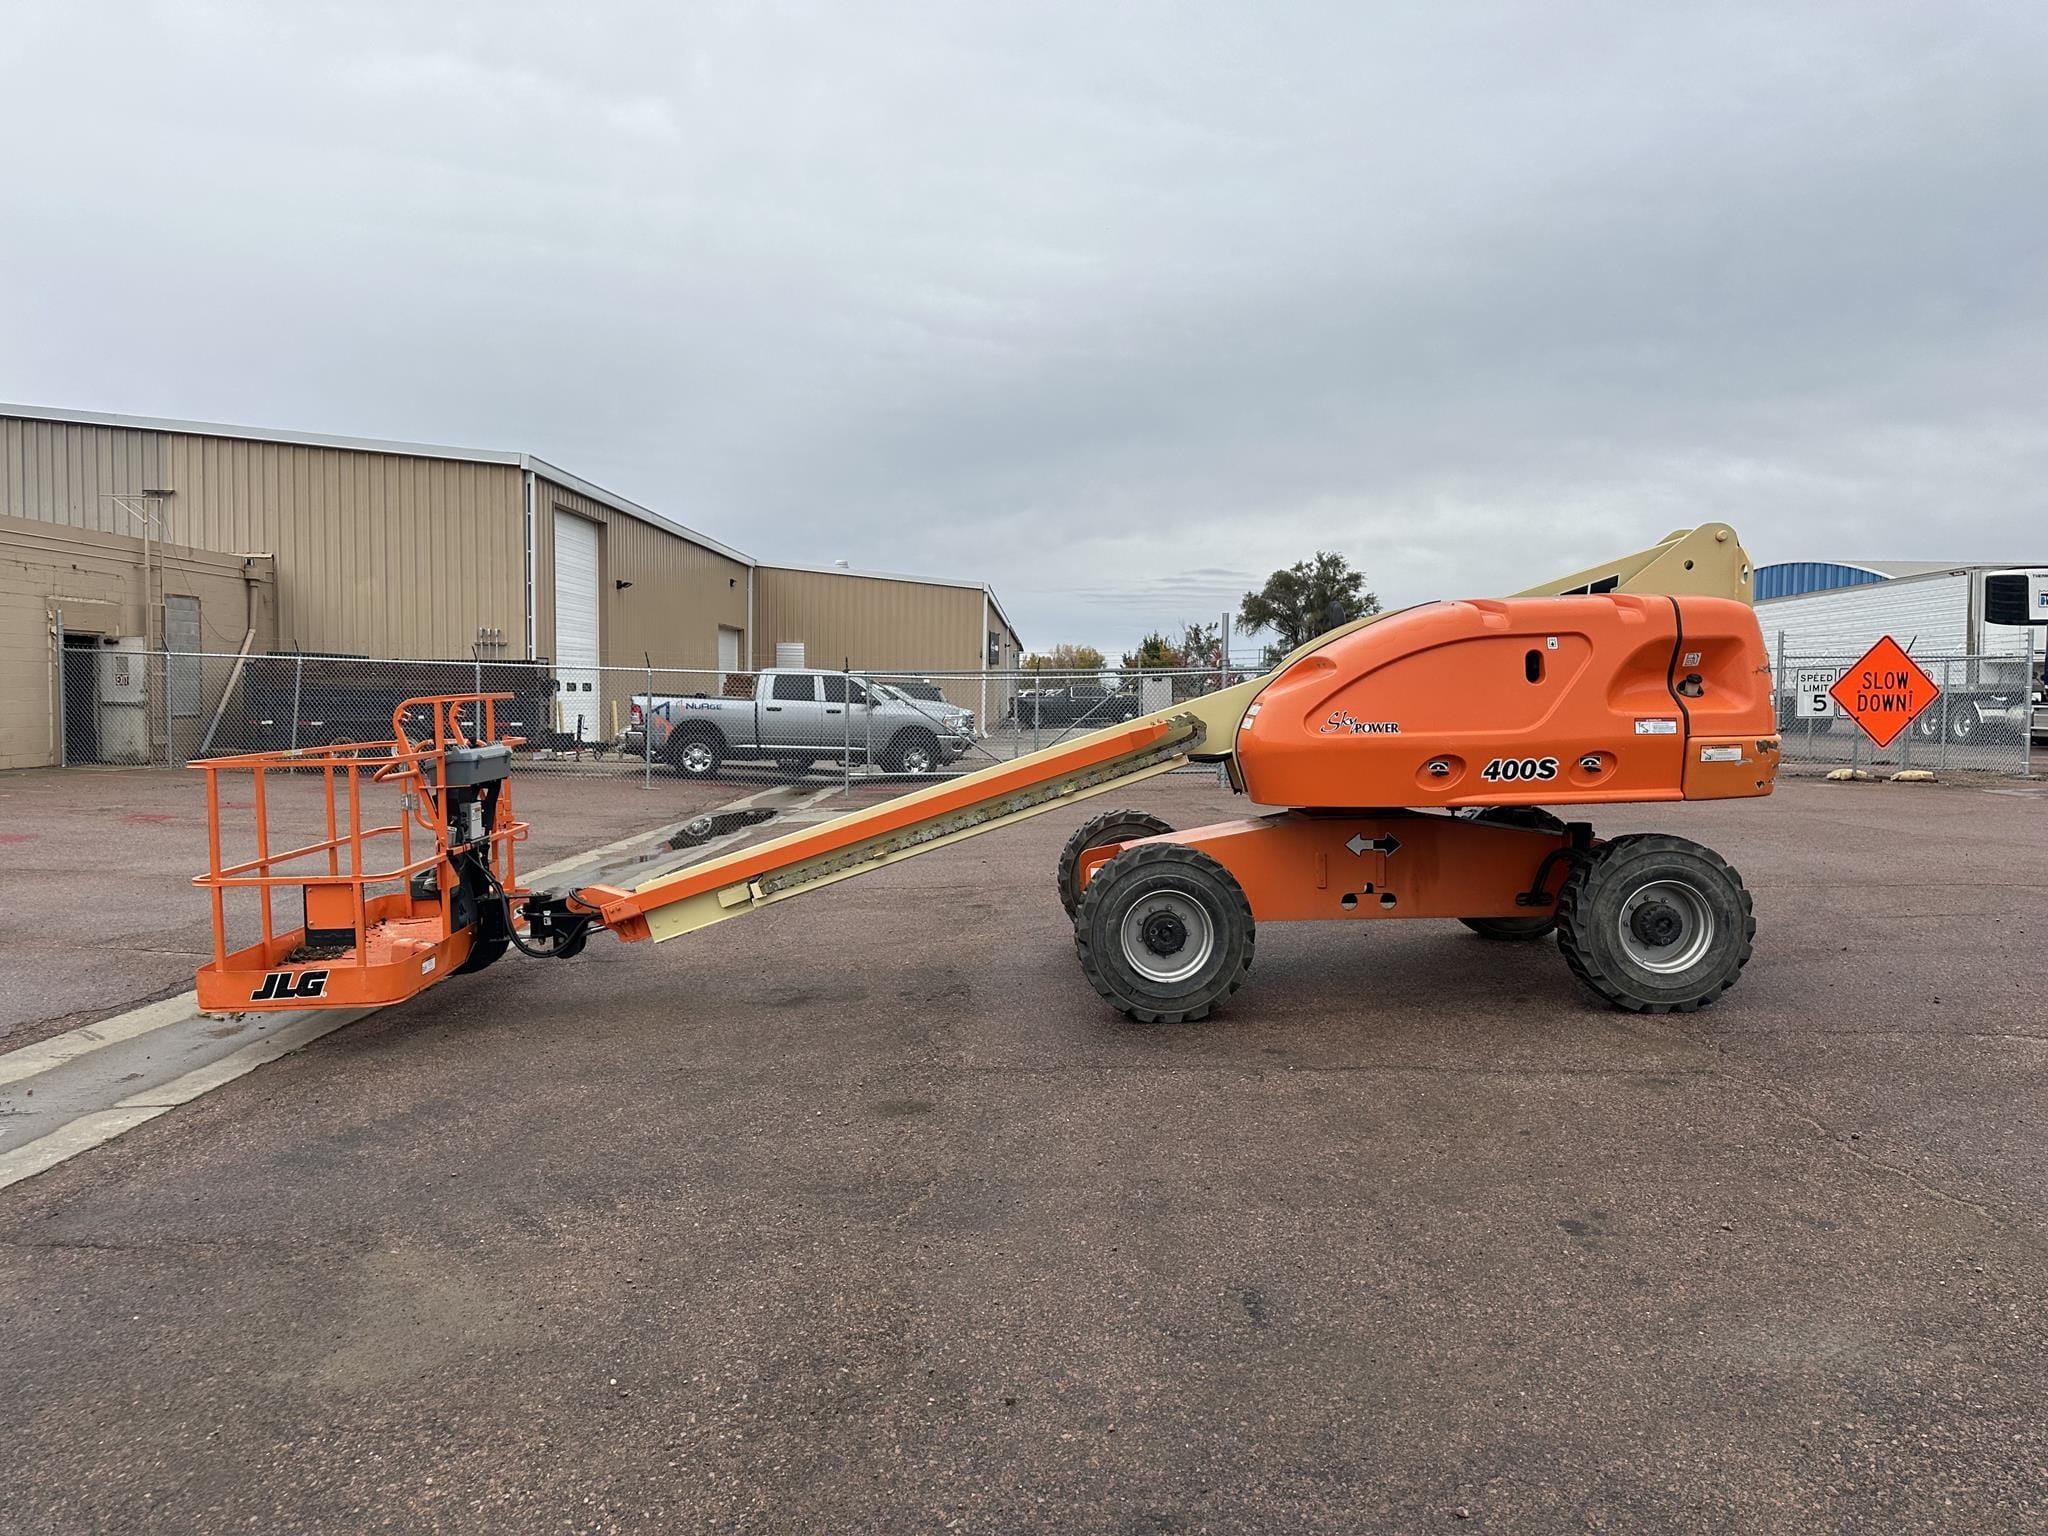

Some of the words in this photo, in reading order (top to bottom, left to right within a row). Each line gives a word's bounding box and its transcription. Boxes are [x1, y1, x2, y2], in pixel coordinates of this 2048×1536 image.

[1800, 674, 1834, 682] SPEED
[1862, 671, 1909, 690] SLOW
[1803, 684, 1830, 692] LIMIT
[1857, 693, 1913, 712] DOWN!
[1480, 757, 1560, 782] 400S
[250, 970, 330, 1001] JLG
